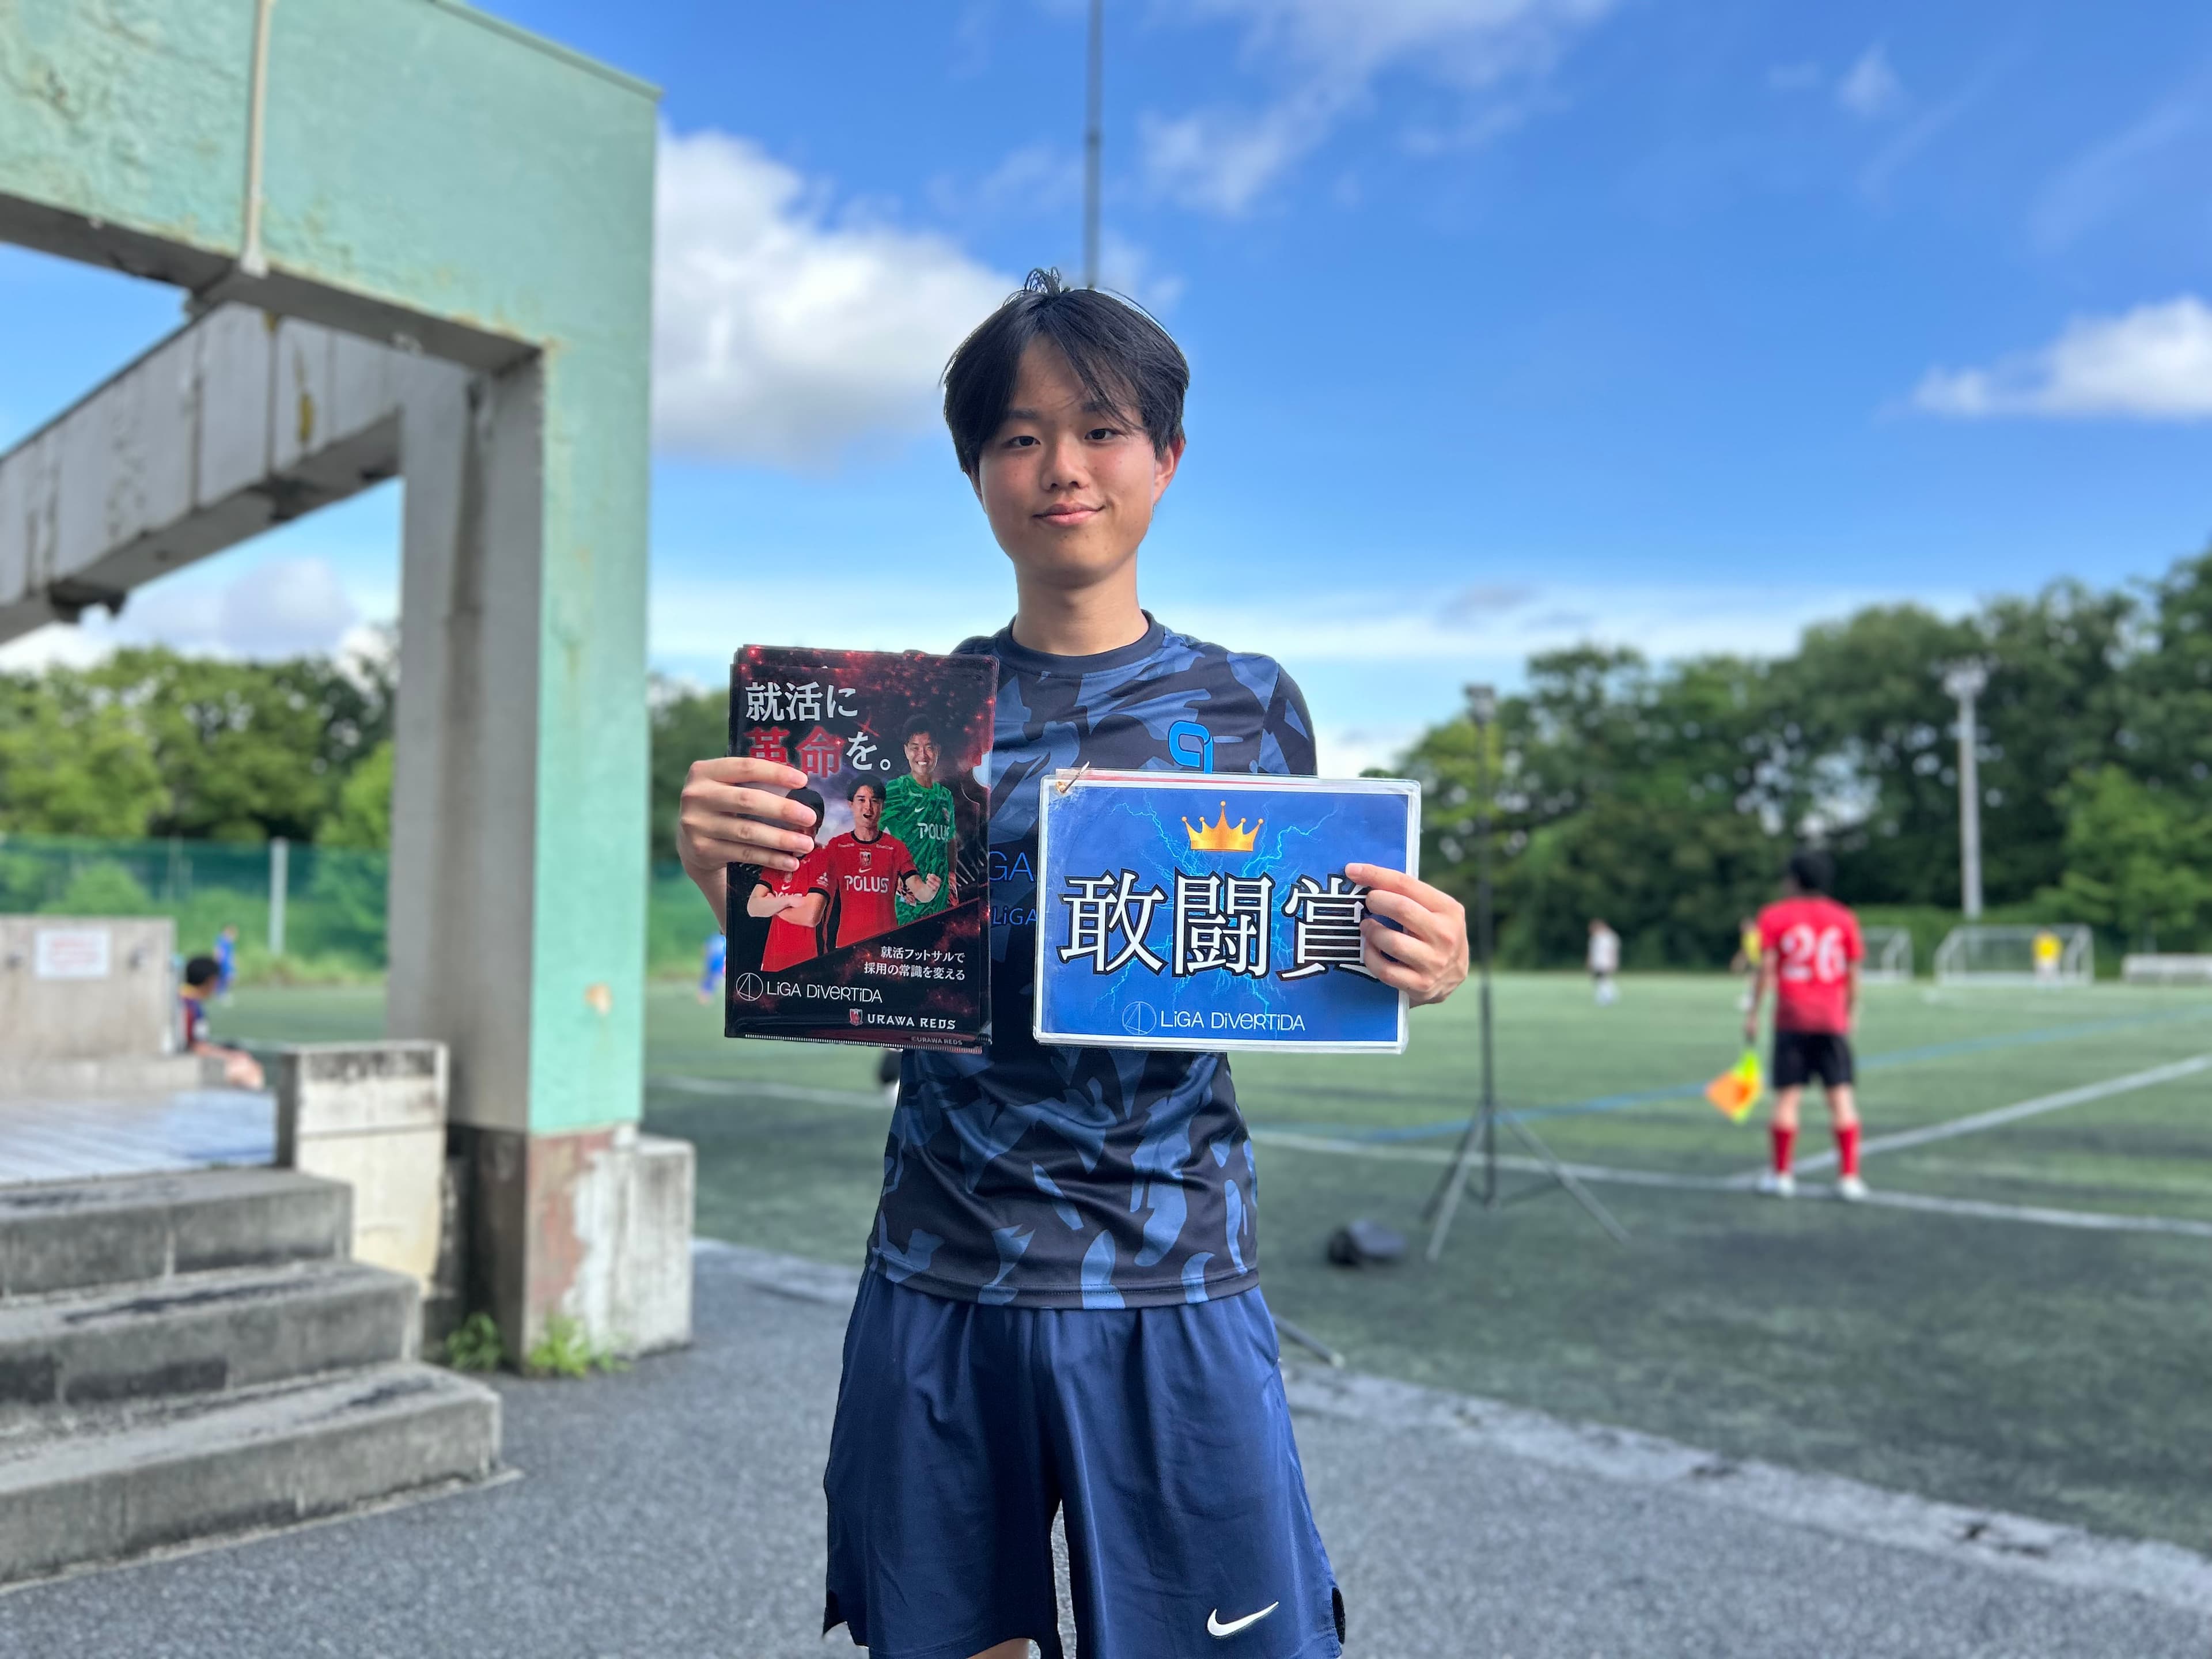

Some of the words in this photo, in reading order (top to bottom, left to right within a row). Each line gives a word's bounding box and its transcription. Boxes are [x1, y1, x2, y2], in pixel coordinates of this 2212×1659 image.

[745, 681, 858, 721] 就活に
[844, 875, 889, 893] POLUS
[1058, 869, 1374, 979] 敢闘賞
[881, 945, 965, 964] 就活フットサルで
[1780, 924, 1847, 984] 26
[863, 961, 965, 980] 採用の常識を変える
[867, 1013, 915, 1027] URAWA
[920, 1017, 956, 1030] REDS
